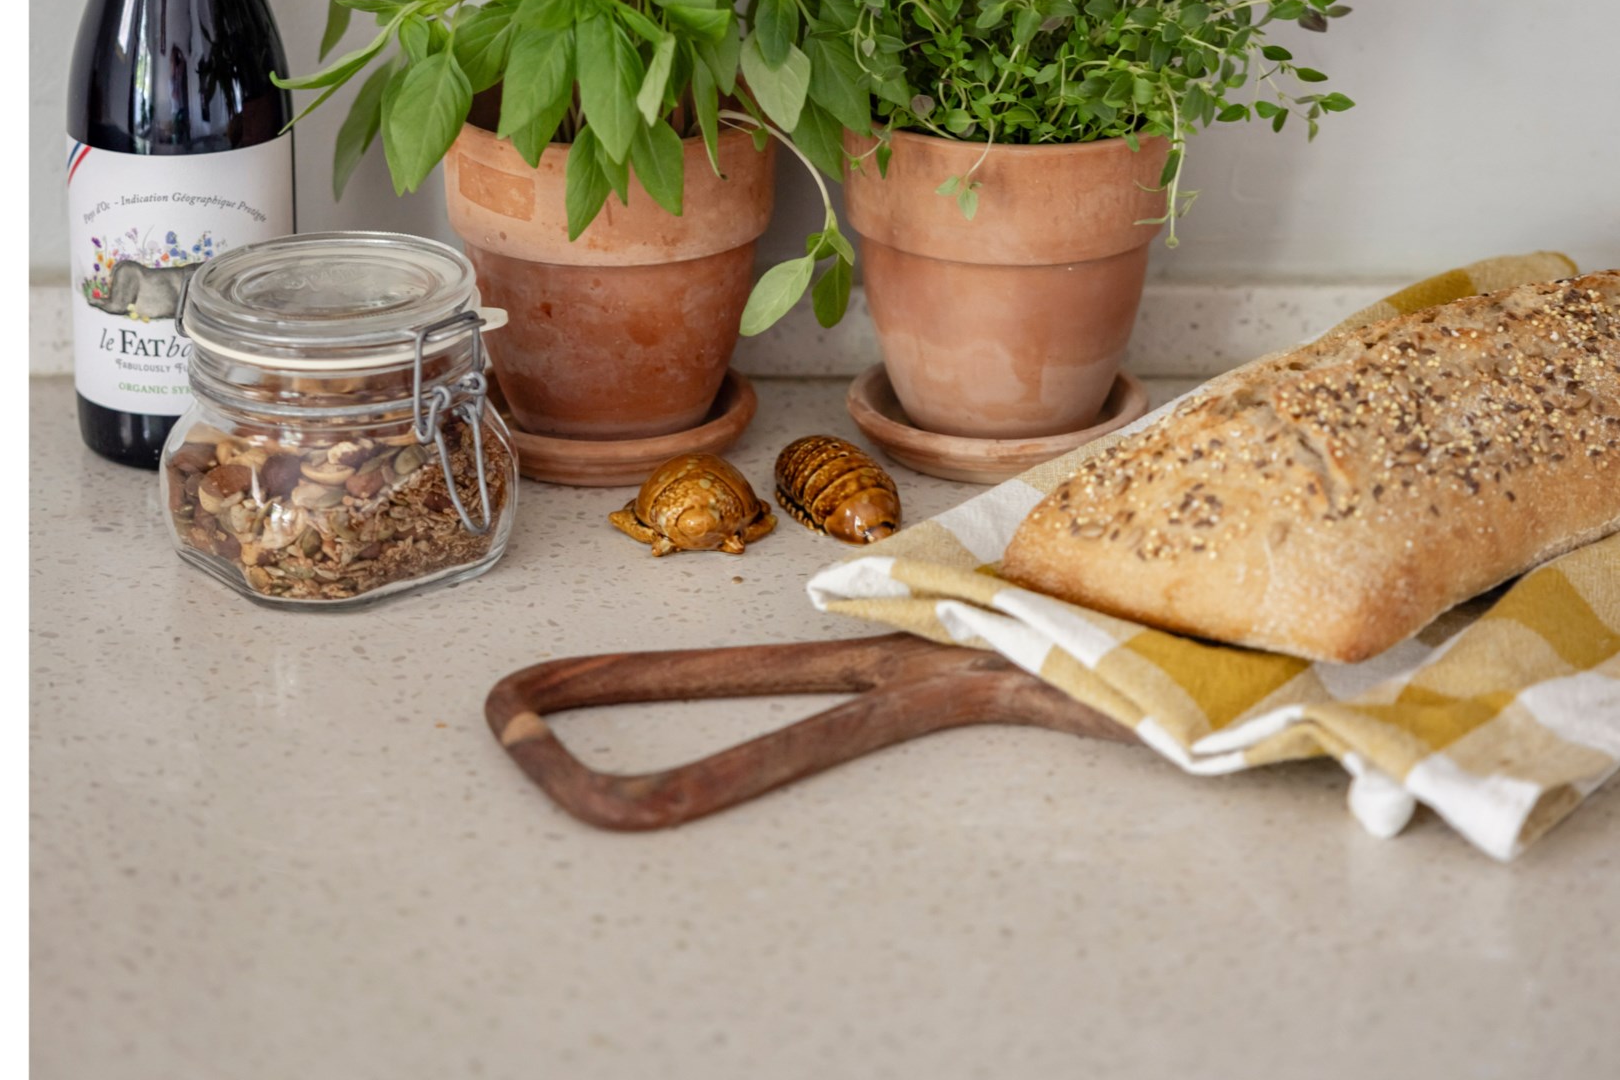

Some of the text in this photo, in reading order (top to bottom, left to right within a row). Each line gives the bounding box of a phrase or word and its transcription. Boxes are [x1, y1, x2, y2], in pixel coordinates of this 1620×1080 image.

[121, 192, 169, 206] Indication
[171, 192, 237, 209] Géographique
[100, 327, 115, 352] le
[118, 382, 168, 395] ORGANIC
